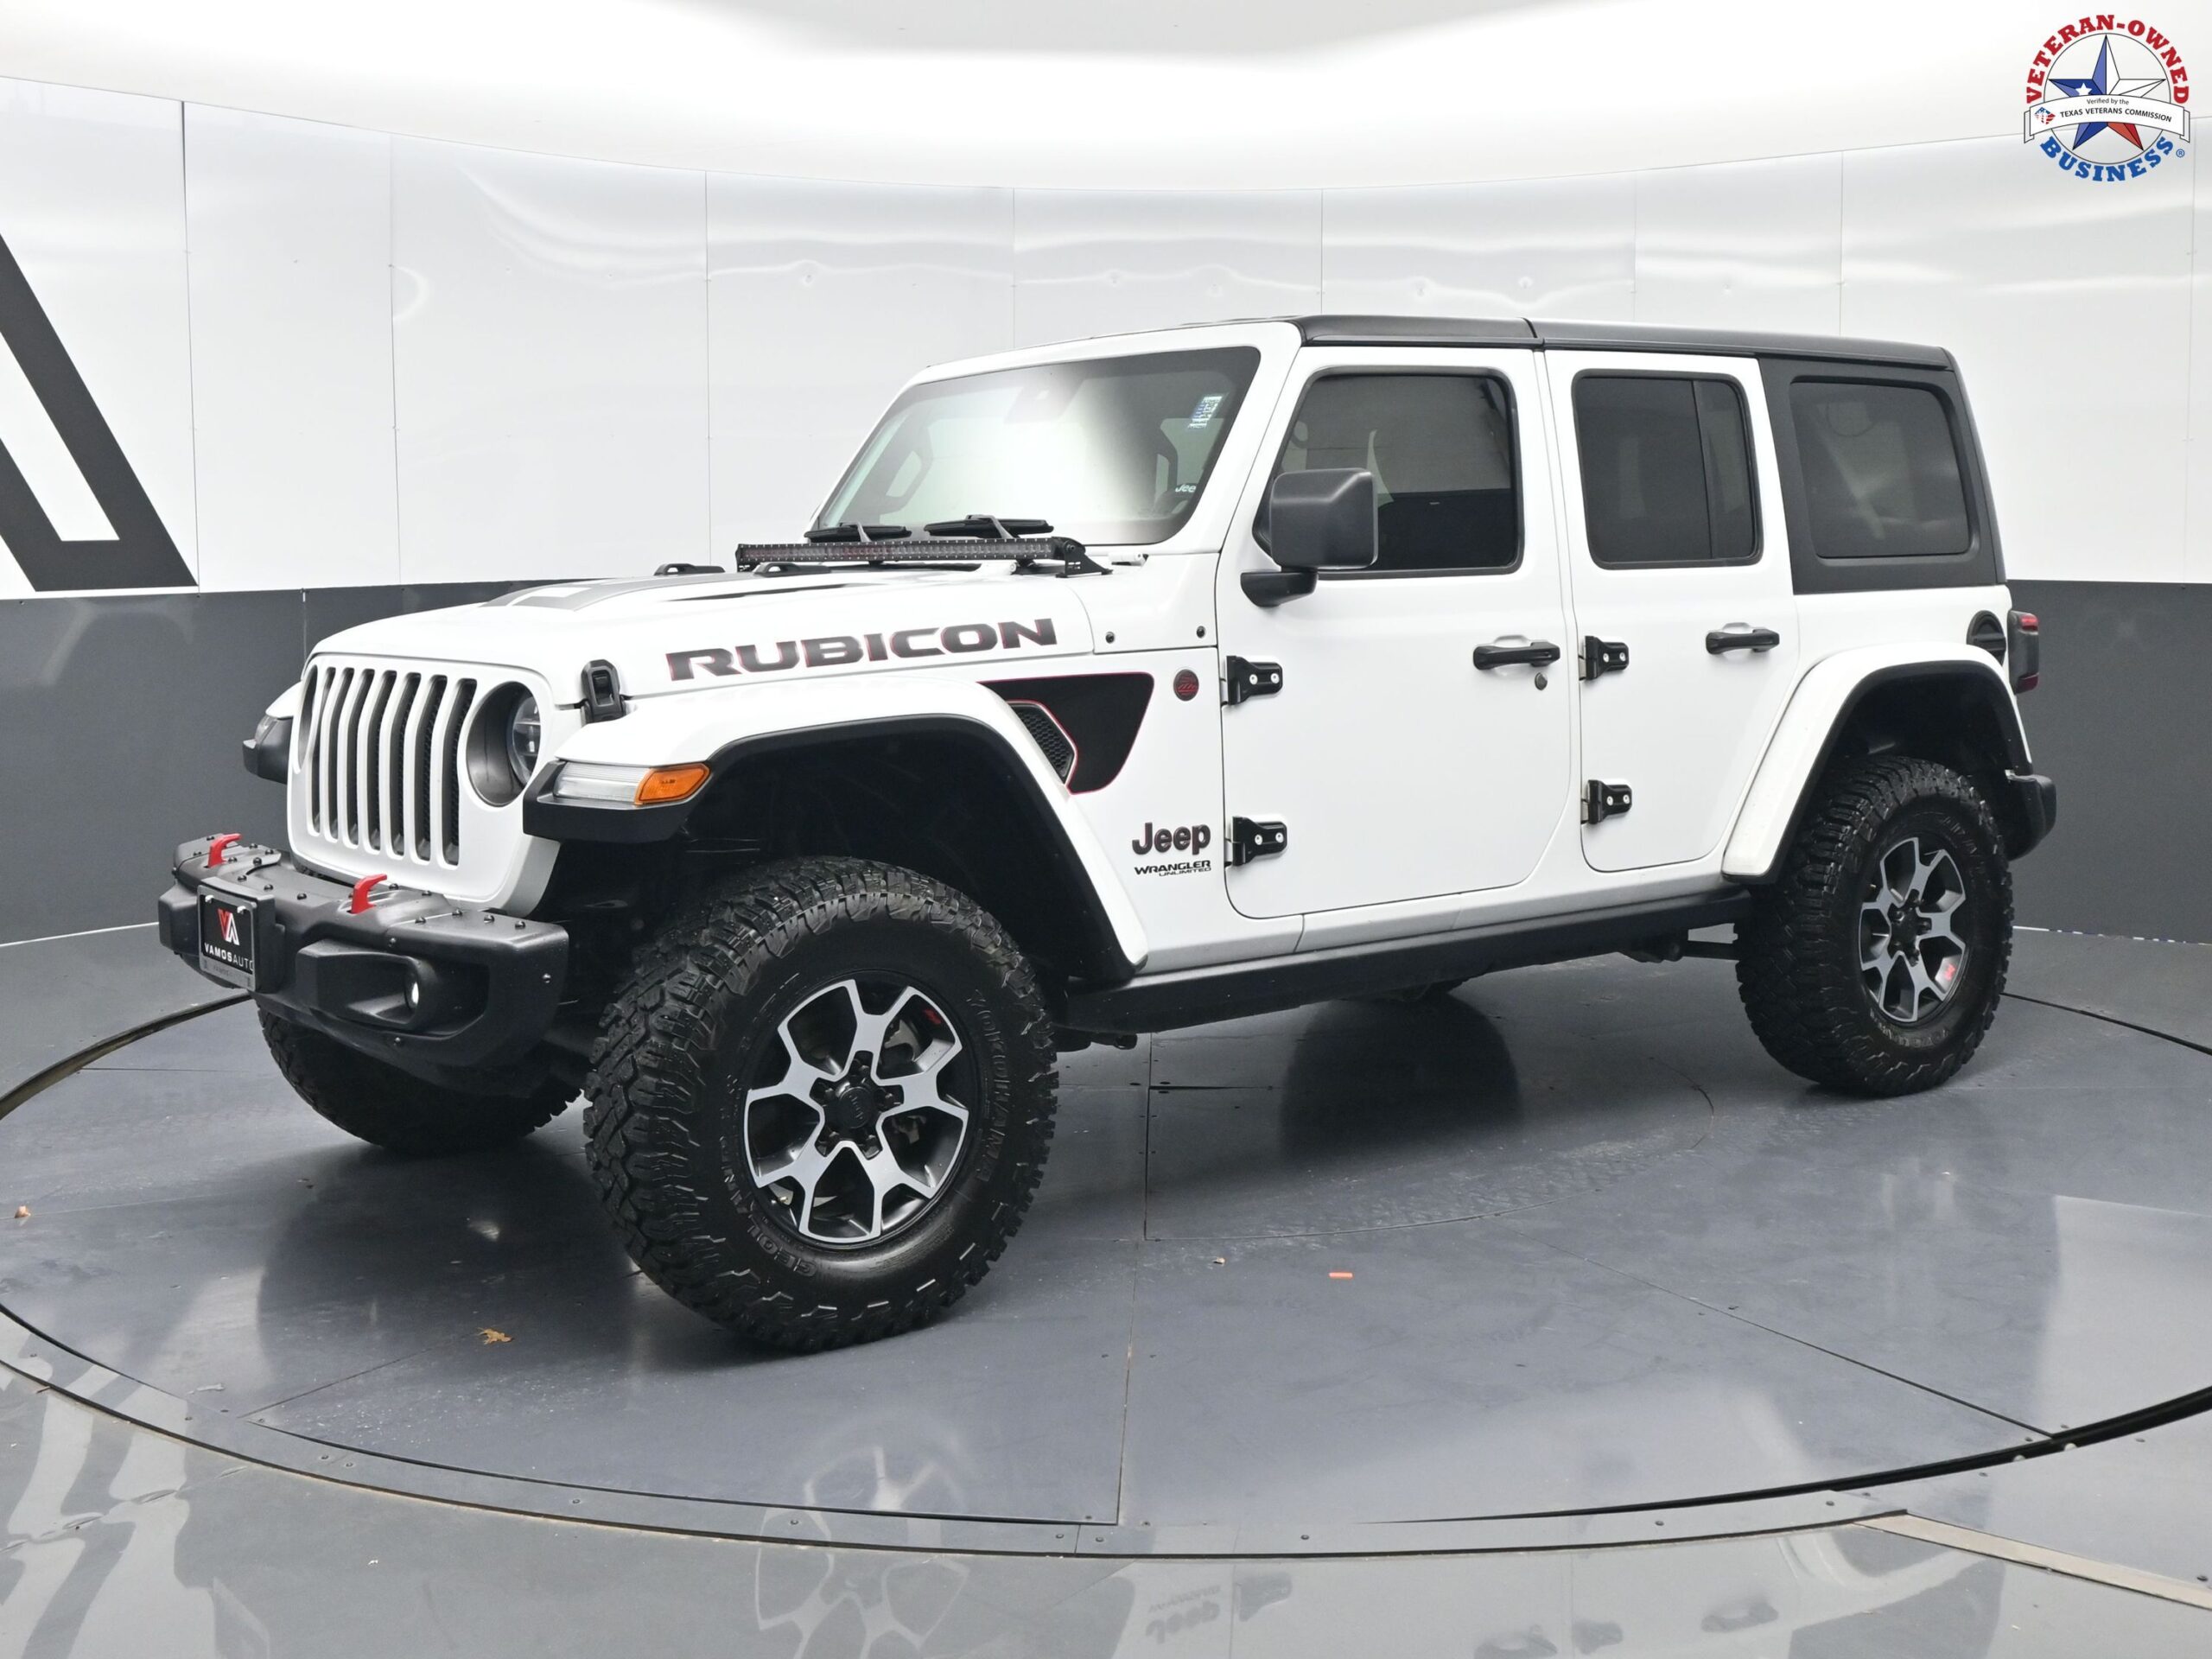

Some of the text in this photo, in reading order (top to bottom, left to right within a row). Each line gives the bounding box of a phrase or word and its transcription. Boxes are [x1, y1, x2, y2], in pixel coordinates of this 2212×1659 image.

[665, 618, 1058, 682] RUBICON
[1131, 822, 1211, 855] Jeep
[1134, 860, 1211, 875] WRANGLER
[1159, 868, 1211, 877] UNLIMITED
